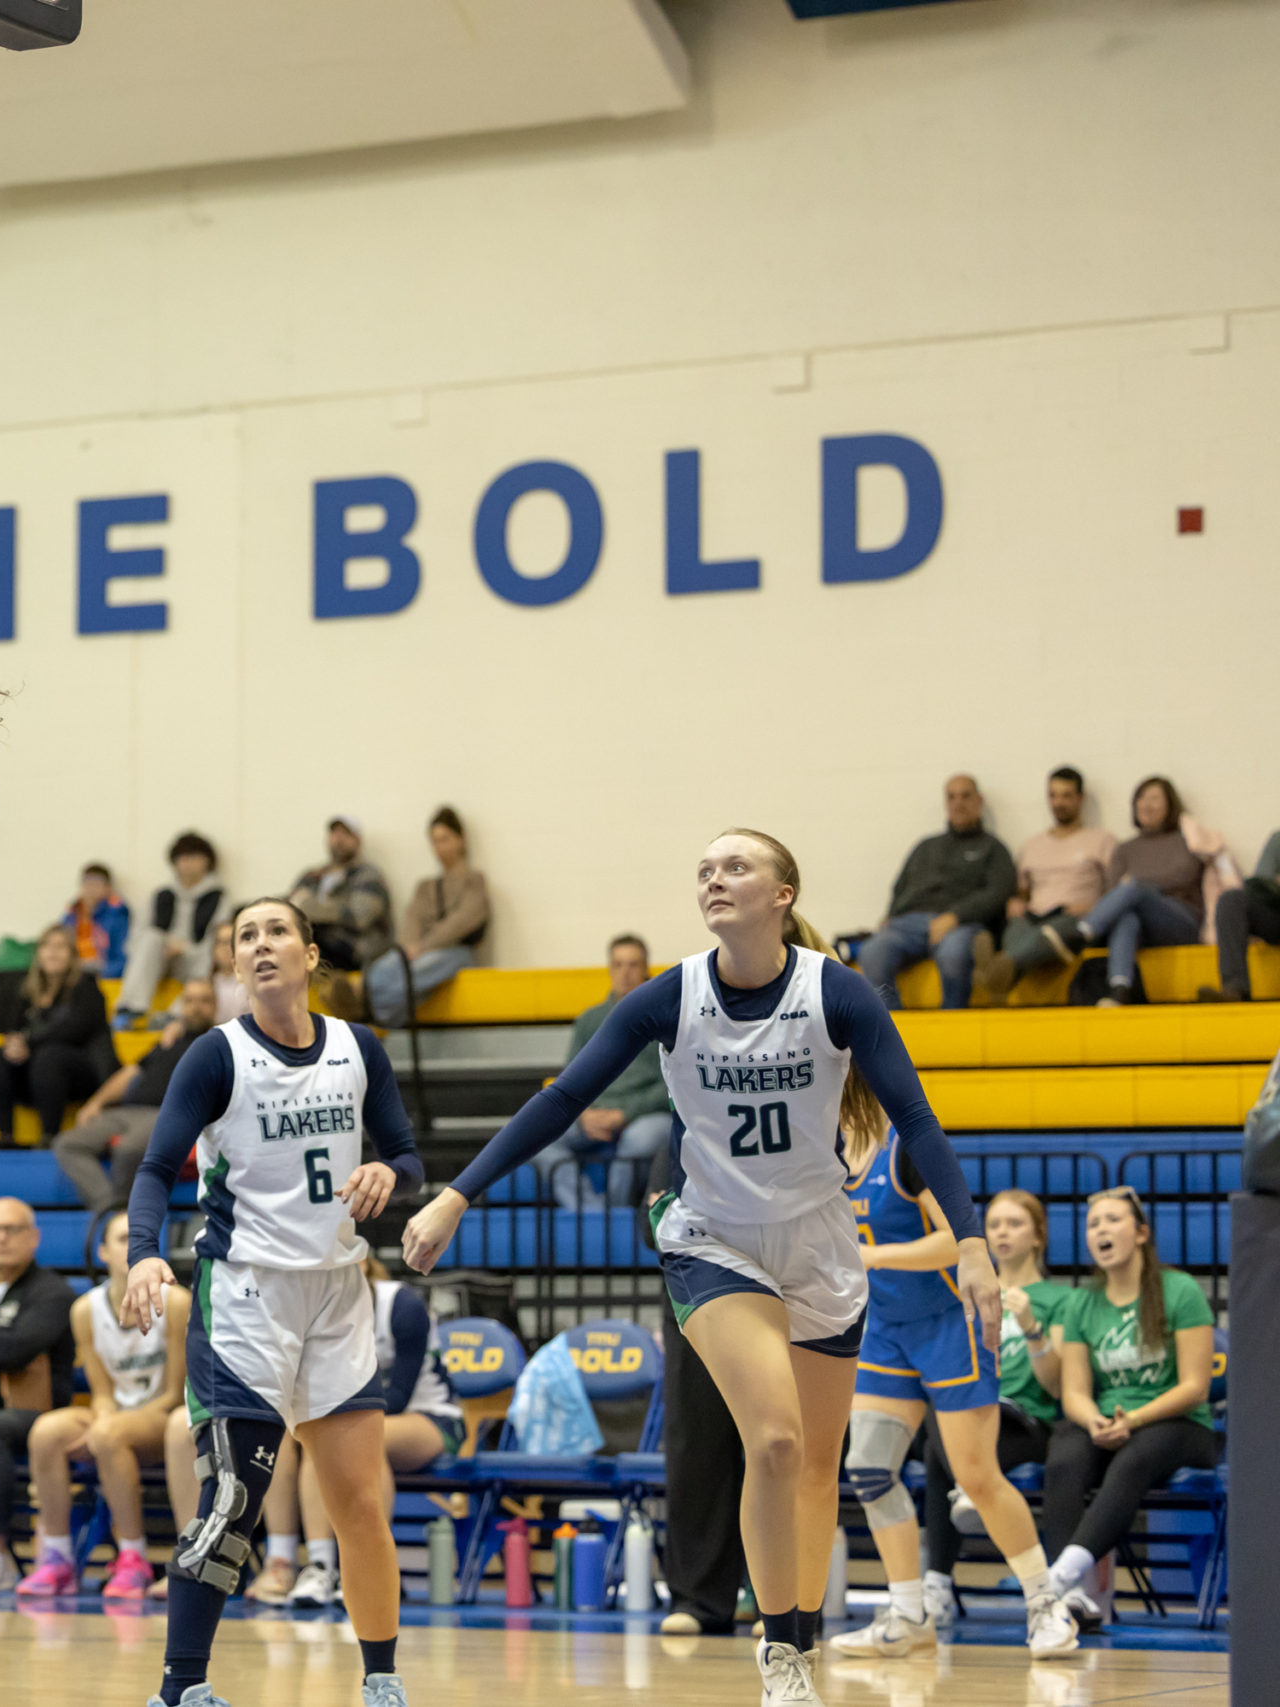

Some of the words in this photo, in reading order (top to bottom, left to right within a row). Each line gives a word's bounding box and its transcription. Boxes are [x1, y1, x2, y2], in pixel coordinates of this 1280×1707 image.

[313, 432, 944, 621] BOLD
[696, 1048, 811, 1063] NIPISSING
[696, 1059, 815, 1093] LAKERS
[256, 1092, 354, 1110] NIPISSING
[257, 1104, 355, 1142] LAKERS
[728, 1101, 791, 1157] 20
[304, 1148, 333, 1204] 6
[444, 1347, 504, 1373] OLD
